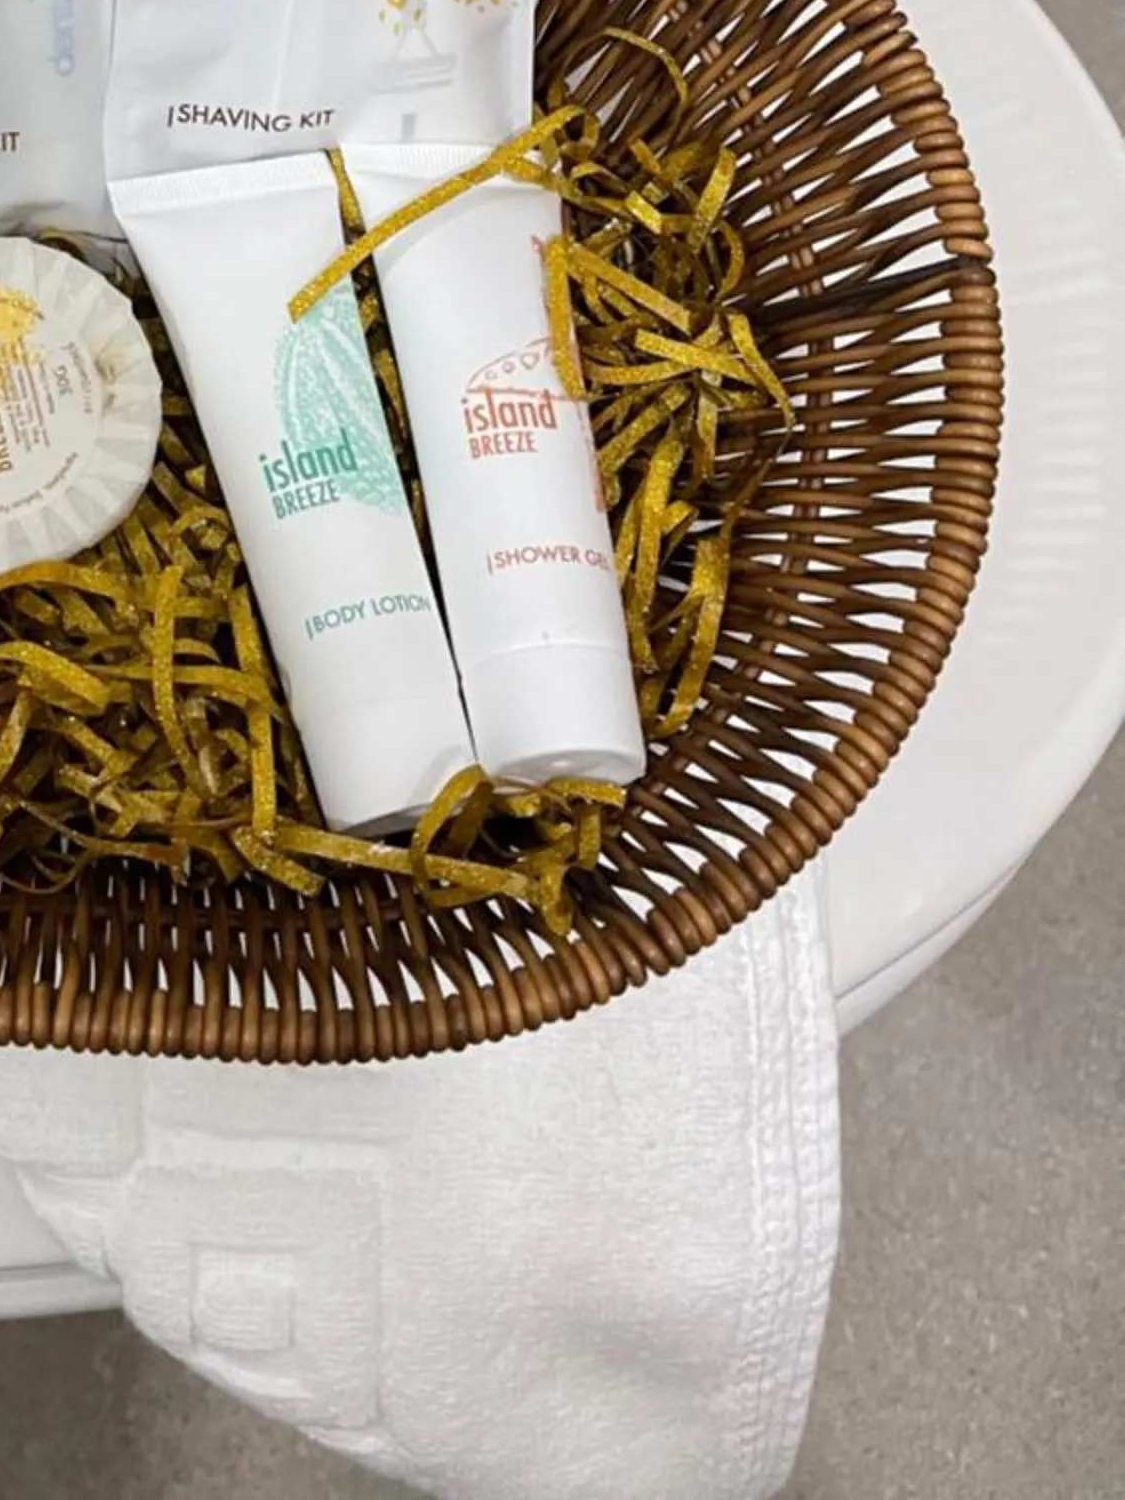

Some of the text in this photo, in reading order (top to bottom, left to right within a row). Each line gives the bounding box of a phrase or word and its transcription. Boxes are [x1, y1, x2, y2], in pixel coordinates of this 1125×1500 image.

[299, 108, 335, 130] KIT
[460, 388, 557, 433] island
[258, 428, 358, 493] island
[468, 431, 538, 460] BREEZE
[272, 478, 341, 520] BREEZE
[494, 545, 581, 569] SHOWER
[313, 594, 432, 634] BODY LOTION
